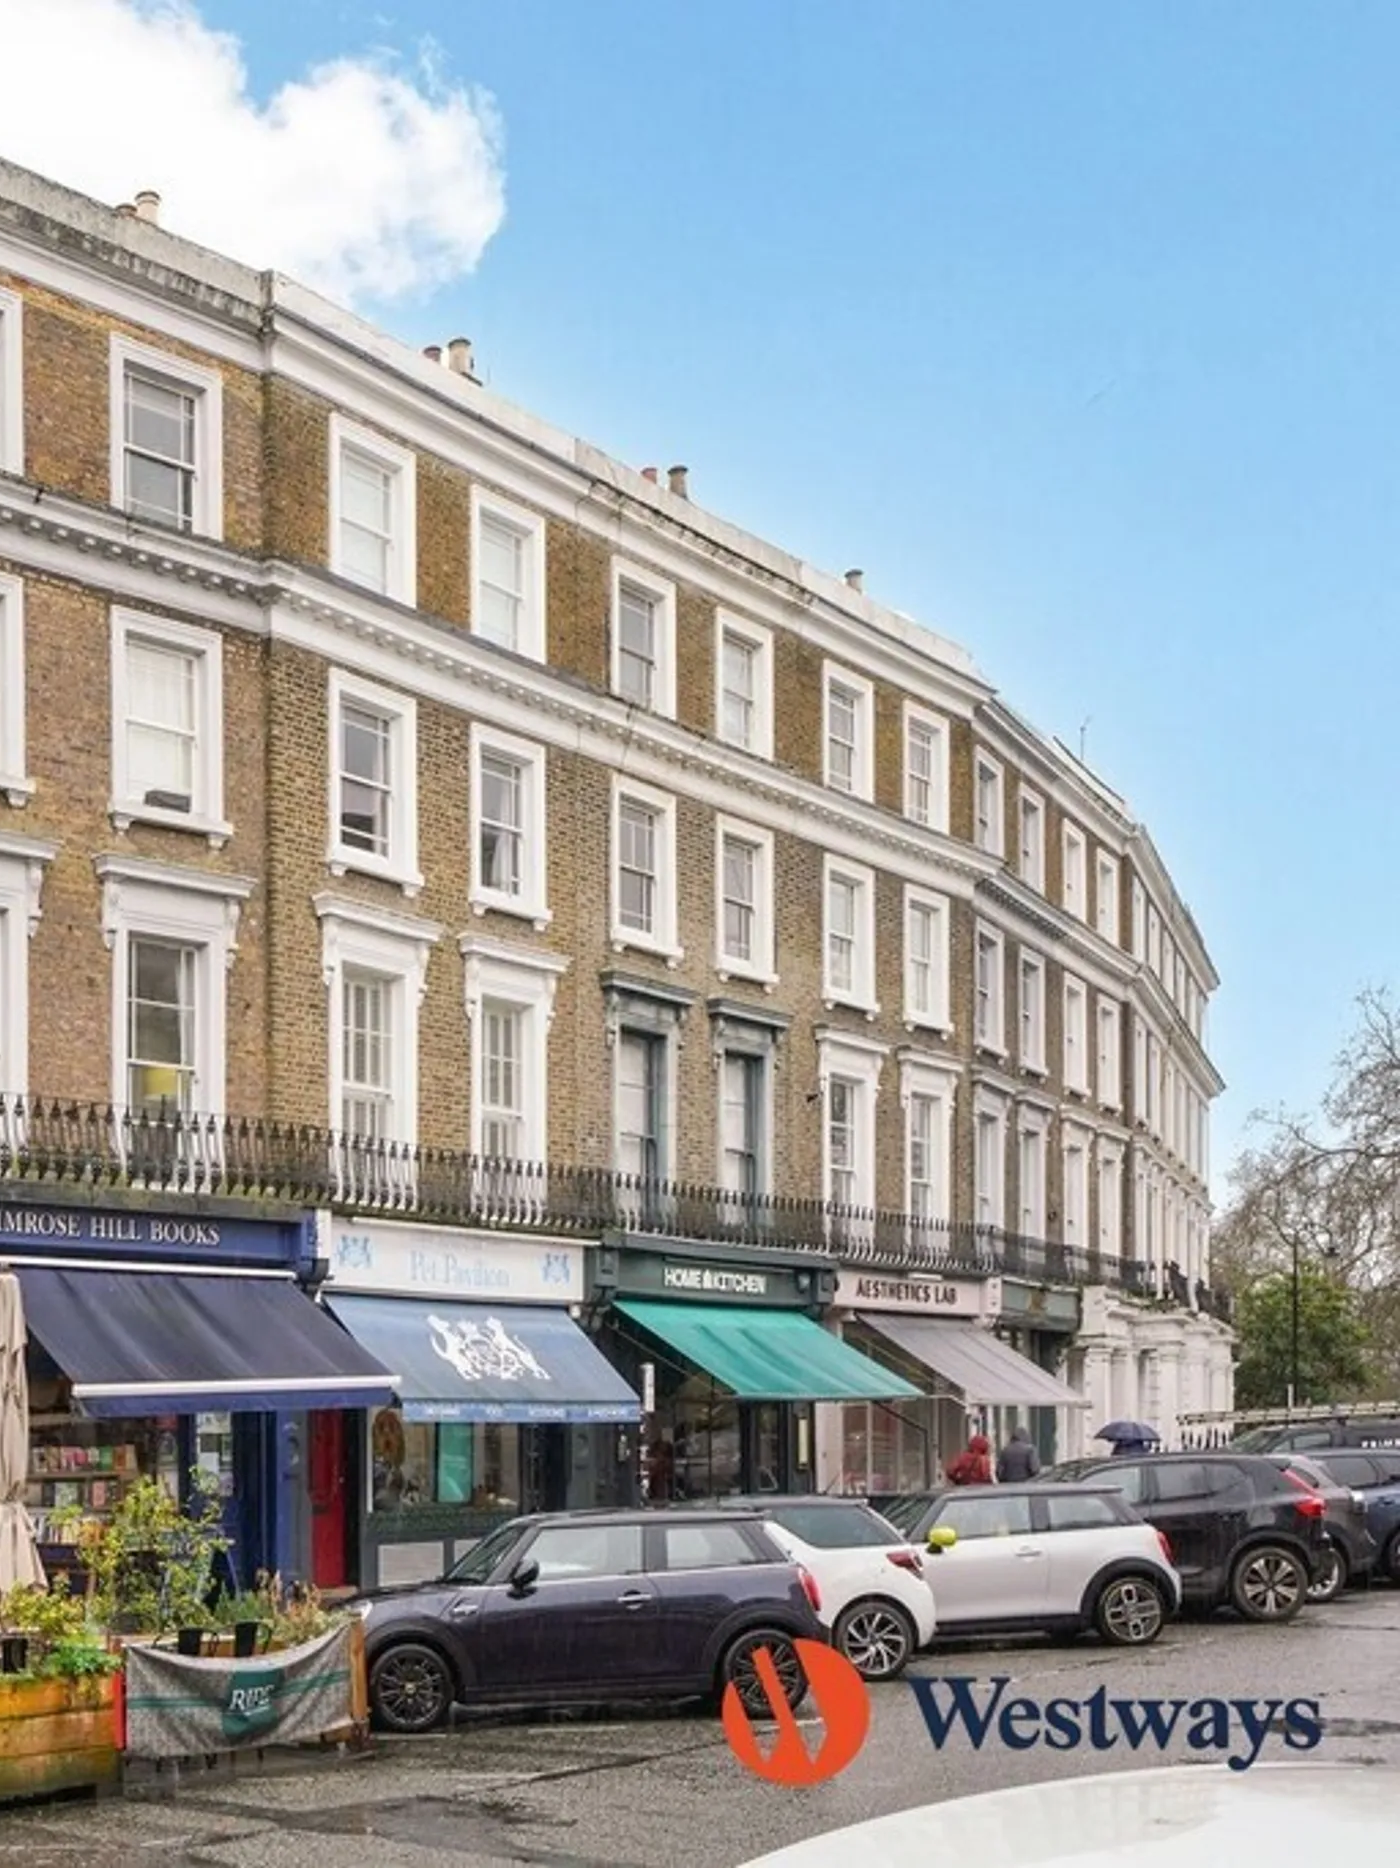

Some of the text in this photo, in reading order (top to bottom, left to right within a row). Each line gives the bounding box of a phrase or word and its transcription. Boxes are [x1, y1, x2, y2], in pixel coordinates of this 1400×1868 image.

[89, 1216, 142, 1242] HILL
[150, 1219, 221, 1246] BOOKS
[663, 1267, 702, 1290] HOME
[855, 1277, 958, 1306] AESTHETICS LAB
